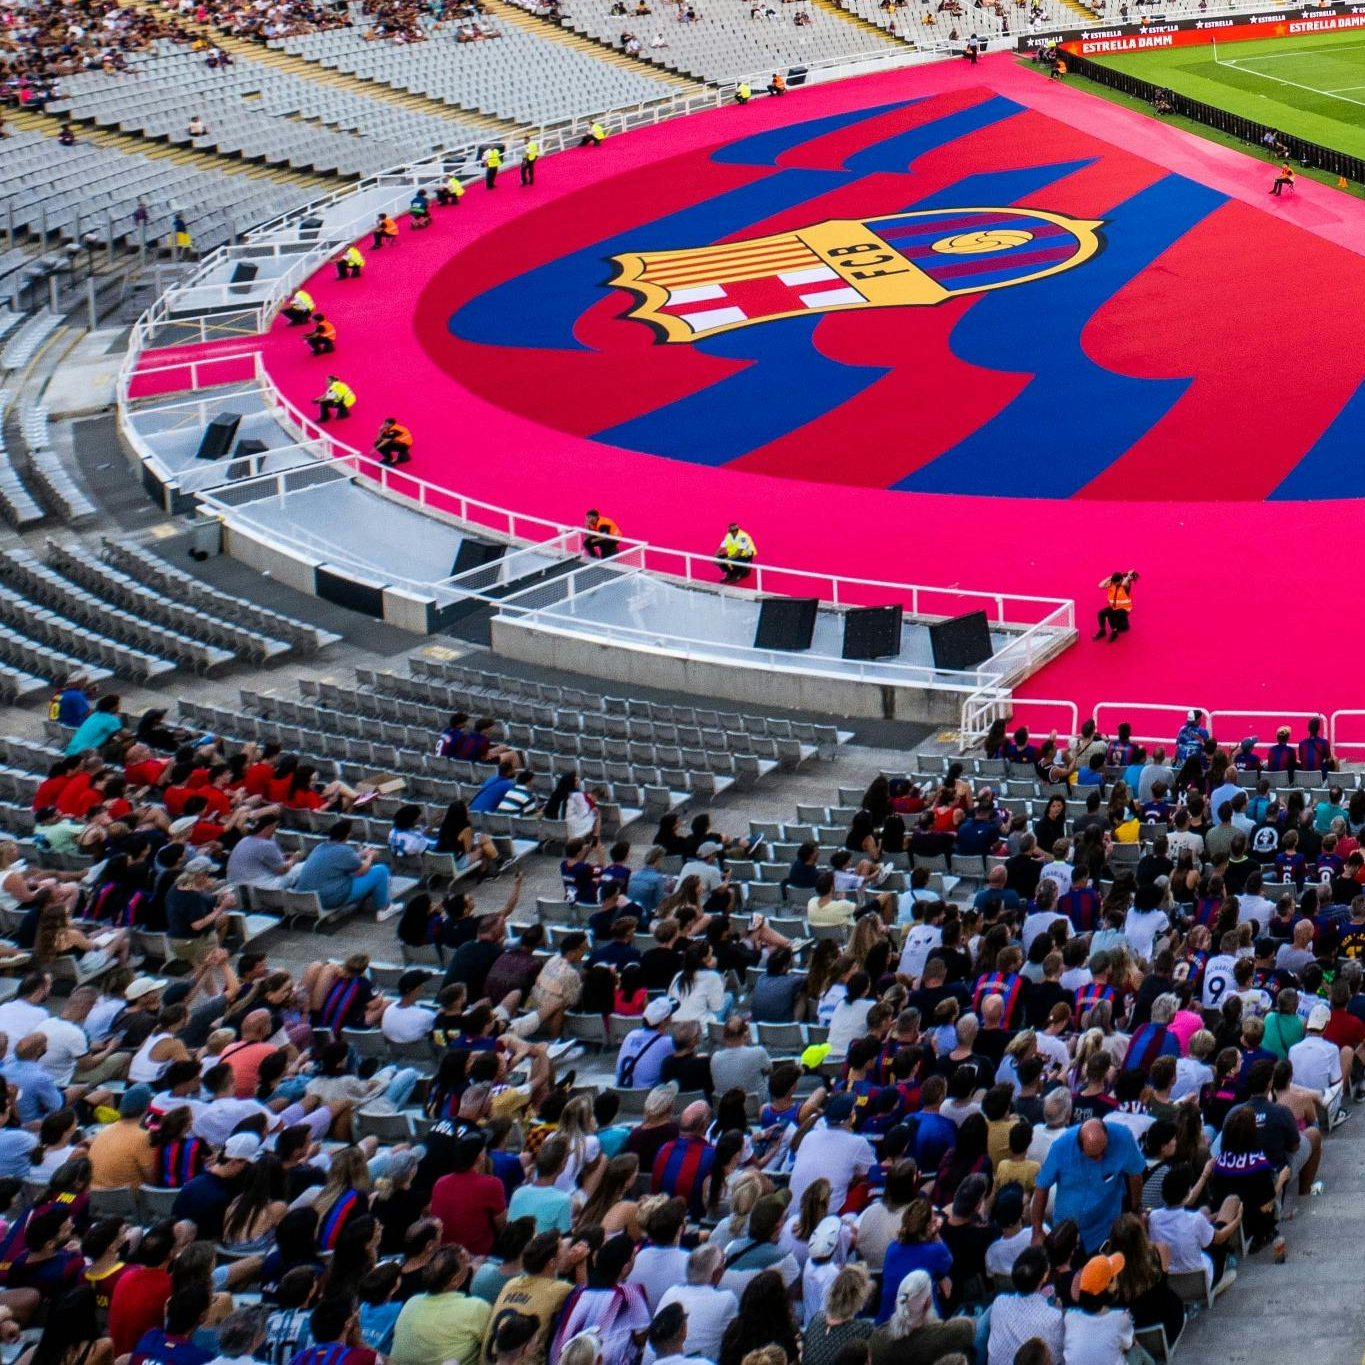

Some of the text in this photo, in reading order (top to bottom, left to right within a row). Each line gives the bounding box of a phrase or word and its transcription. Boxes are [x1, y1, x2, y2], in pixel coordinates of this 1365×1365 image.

[1258, 15, 1286, 24] ESTRELLA
[1309, 10, 1336, 18] ESTRELLA
[1204, 20, 1233, 29] ESTRELLA
[1290, 20, 1336, 33] ESTRELLA
[1090, 30, 1122, 39] ESTRELLA
[1083, 35, 1172, 53] ESTRELLA DAMM
[827, 243, 910, 280] FCB
[1208, 976, 1226, 1004] 9
